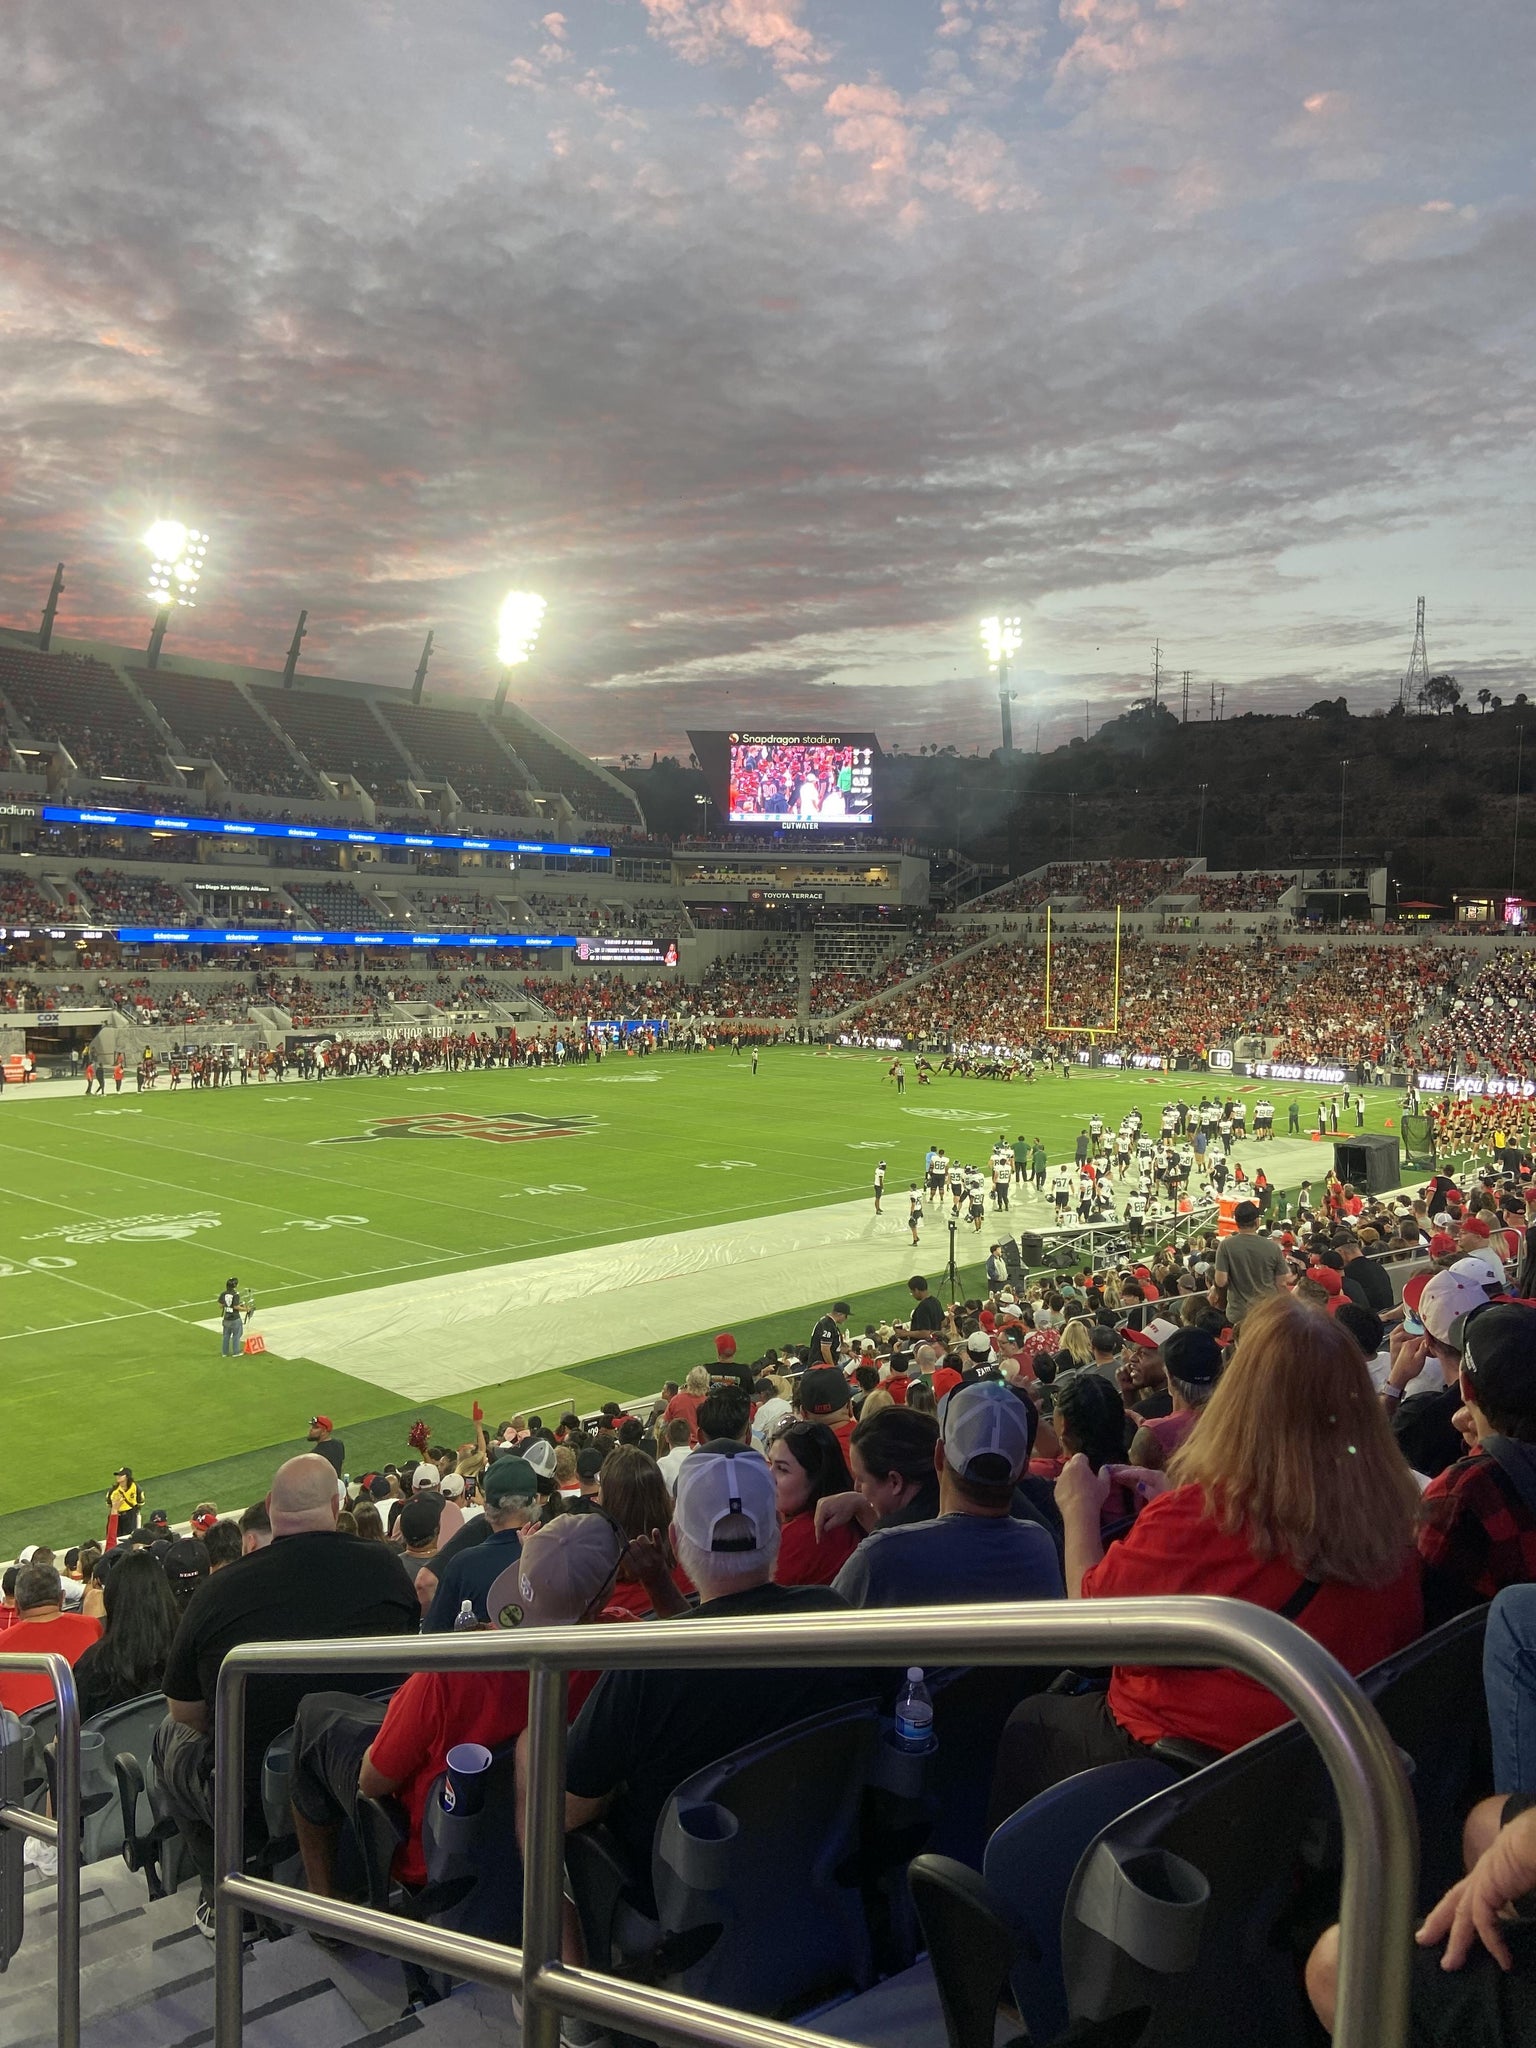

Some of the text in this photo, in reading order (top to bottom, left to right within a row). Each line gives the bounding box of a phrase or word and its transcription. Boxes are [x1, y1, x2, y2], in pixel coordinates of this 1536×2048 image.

[743, 734, 840, 745] Snapdragon stadium
[782, 822, 819, 830] CUTWATER
[346, 1030, 381, 1038] Snapdragon
[1271, 1065, 1302, 1079] TACO
[1304, 1068, 1345, 1082] STAND
[1418, 1076, 1445, 1089] THE
[694, 1160, 758, 1171] 50
[522, 1183, 588, 1196] 40
[283, 1214, 370, 1231] 30
[250, 1336, 265, 1352] 20
[179, 1570, 199, 1578] STATE
